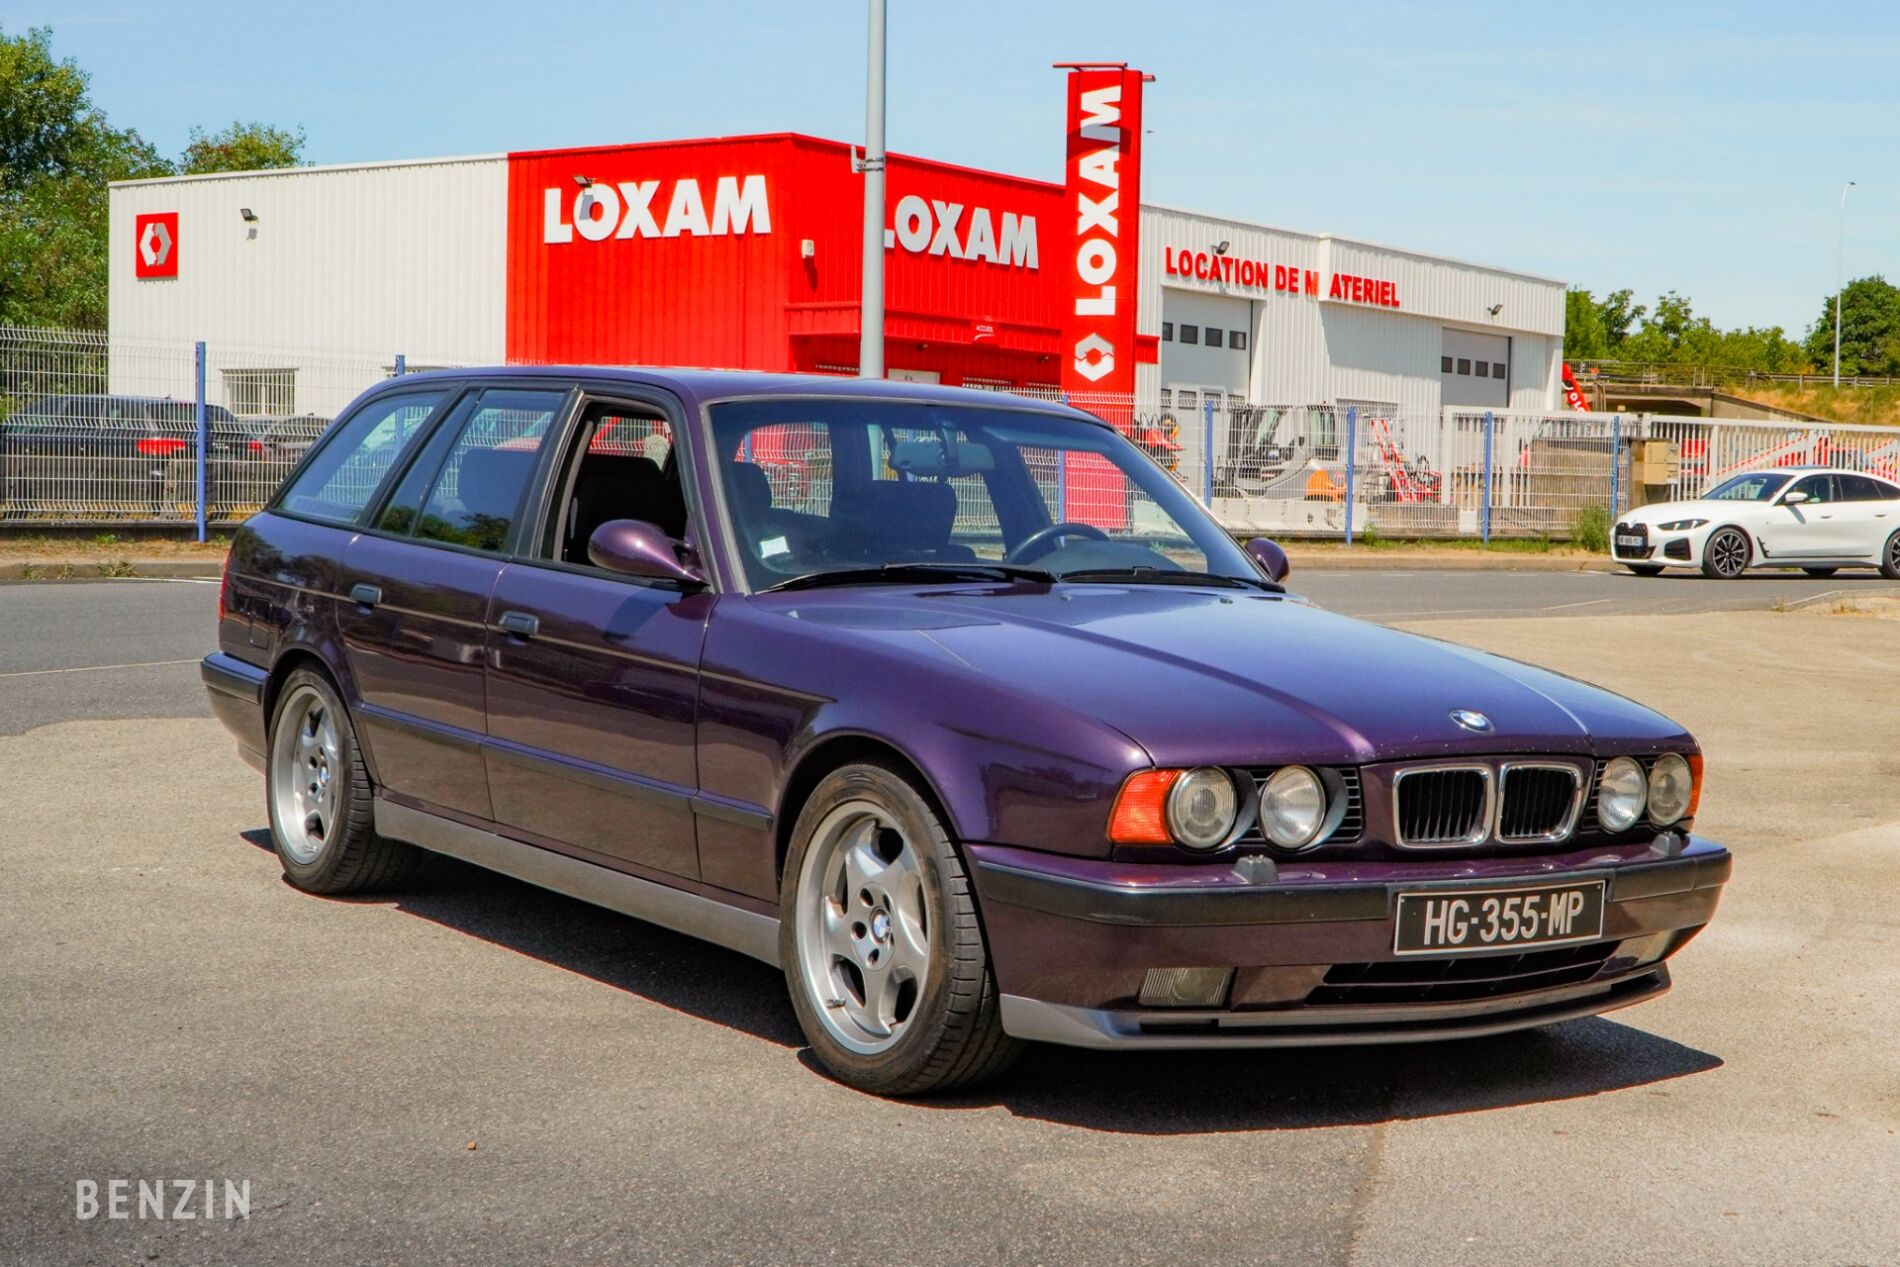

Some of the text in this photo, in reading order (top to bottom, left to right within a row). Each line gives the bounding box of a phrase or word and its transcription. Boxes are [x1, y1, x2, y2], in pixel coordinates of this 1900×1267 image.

[544, 175, 772, 243] LOXAM
[1075, 85, 1122, 316] LOXAM
[1165, 247, 1268, 288] LOCATION
[1275, 265, 1299, 293] DE
[1423, 891, 1584, 945] HG-355-MP
